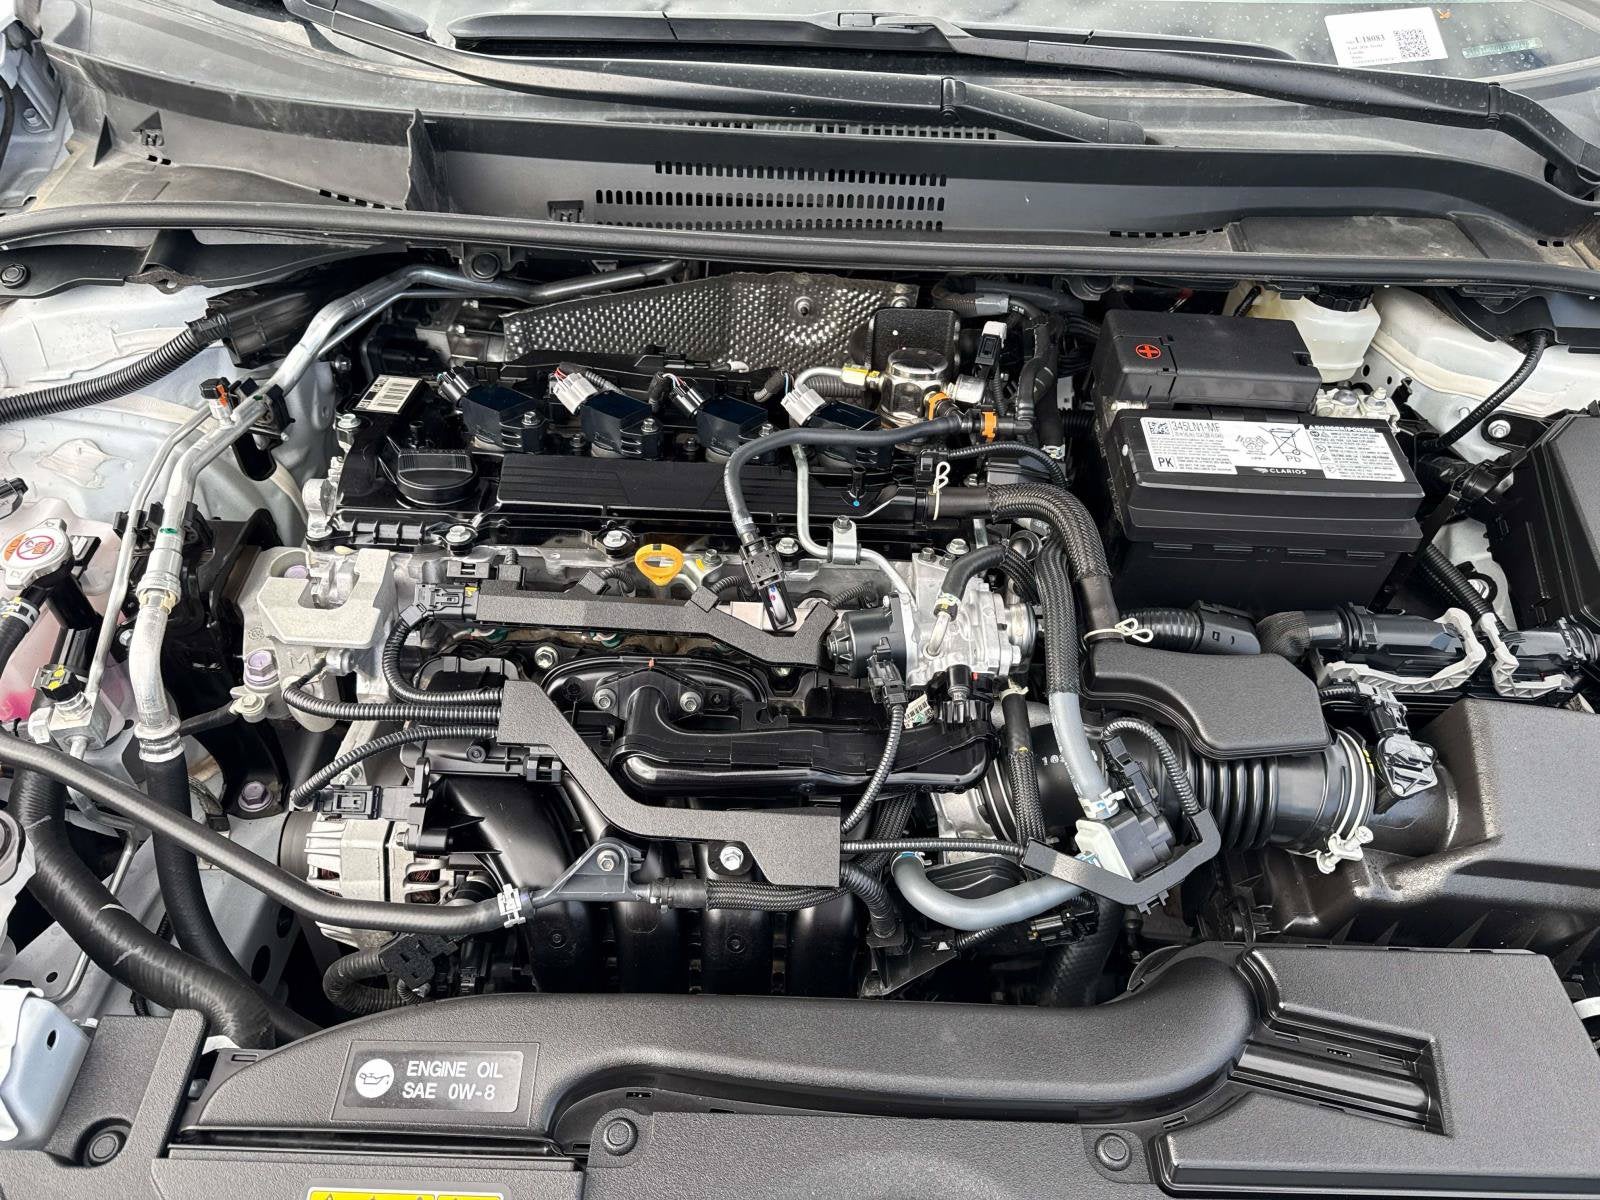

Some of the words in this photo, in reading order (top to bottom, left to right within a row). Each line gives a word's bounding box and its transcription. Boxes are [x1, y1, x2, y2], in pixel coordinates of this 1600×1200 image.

[1157, 457, 1175, 468] PK
[1285, 455, 1302, 463] Pb
[406, 1060, 468, 1078] ENGINE
[476, 1061, 504, 1079] OIL
[402, 1082, 438, 1099] SAE
[447, 1083, 496, 1101] 0W-8
